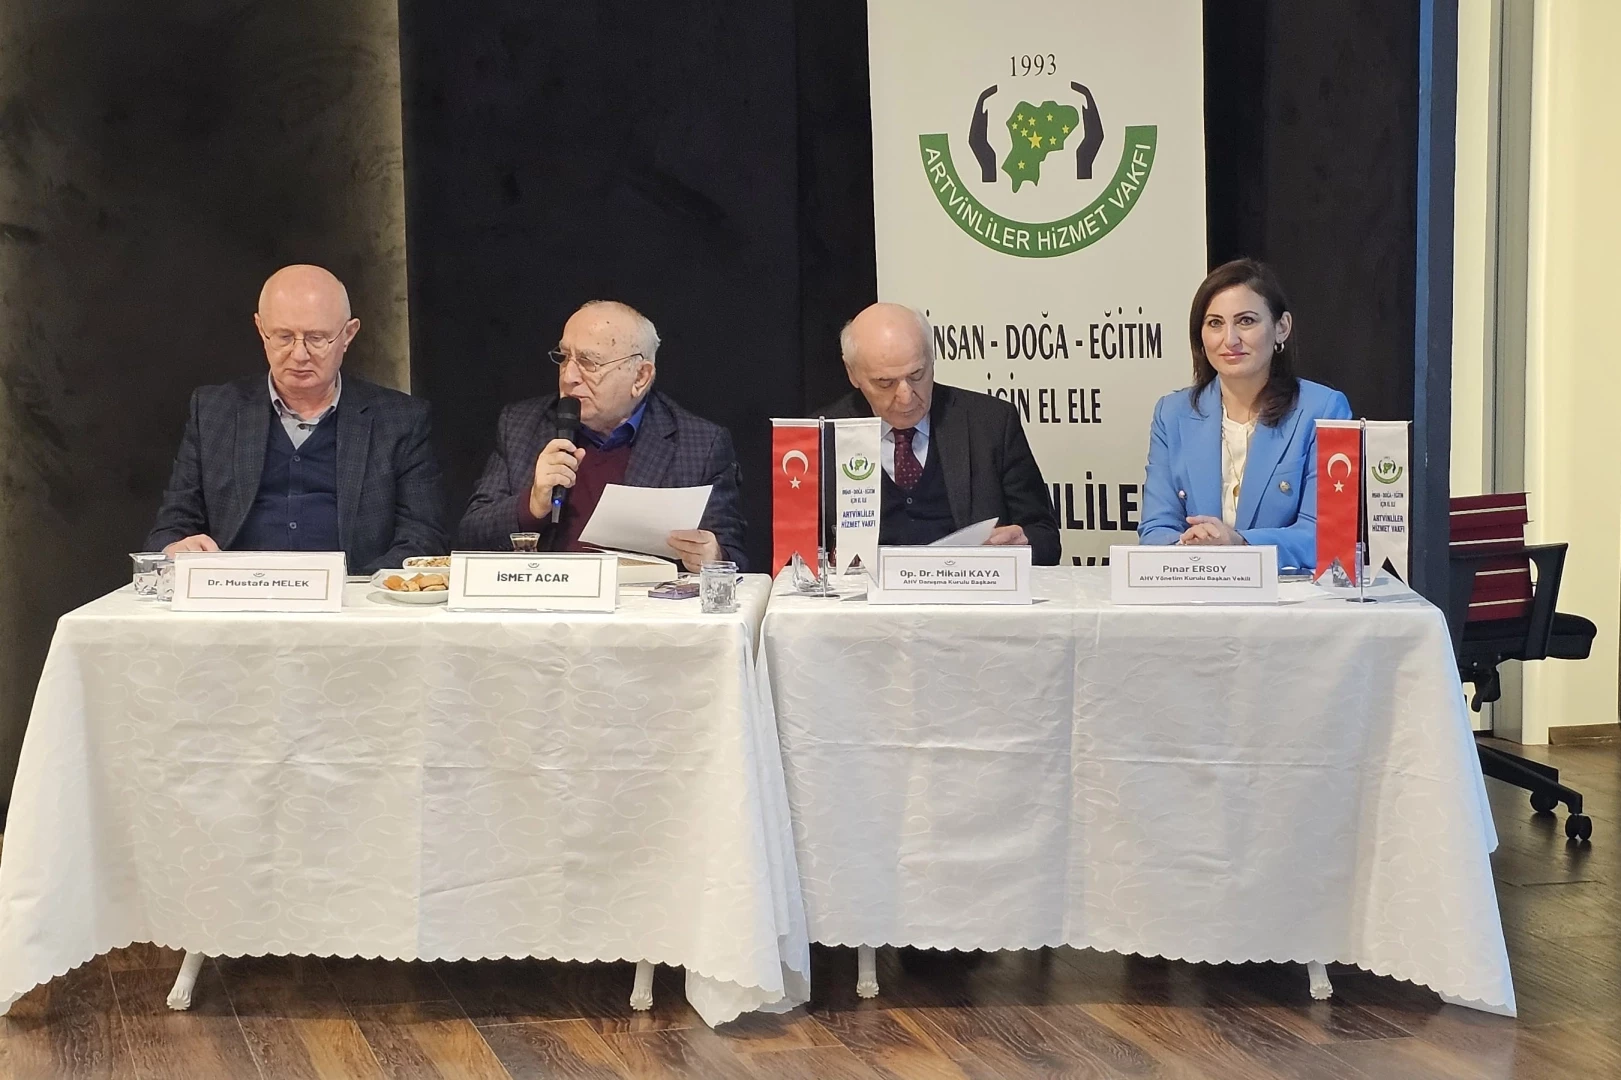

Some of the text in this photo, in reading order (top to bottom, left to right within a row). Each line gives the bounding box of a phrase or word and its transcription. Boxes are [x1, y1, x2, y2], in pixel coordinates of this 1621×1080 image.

[1010, 54, 1057, 76] 1993
[925, 143, 1151, 250] ARTVİNLİLER HİZMET VAKFI
[926, 309, 985, 360] NSAN
[1005, 311, 1069, 360] DOĞA
[1089, 307, 1162, 360] EĞİTİM
[1038, 388, 1061, 424] EL
[1067, 388, 1102, 424] ELE
[1043, 471, 1145, 531] NLİLE
[225, 579, 270, 587] Mustafa
[497, 571, 570, 582] İSMET ACAR
[900, 570, 1000, 580] Op. Dr. Mikail KAYA
